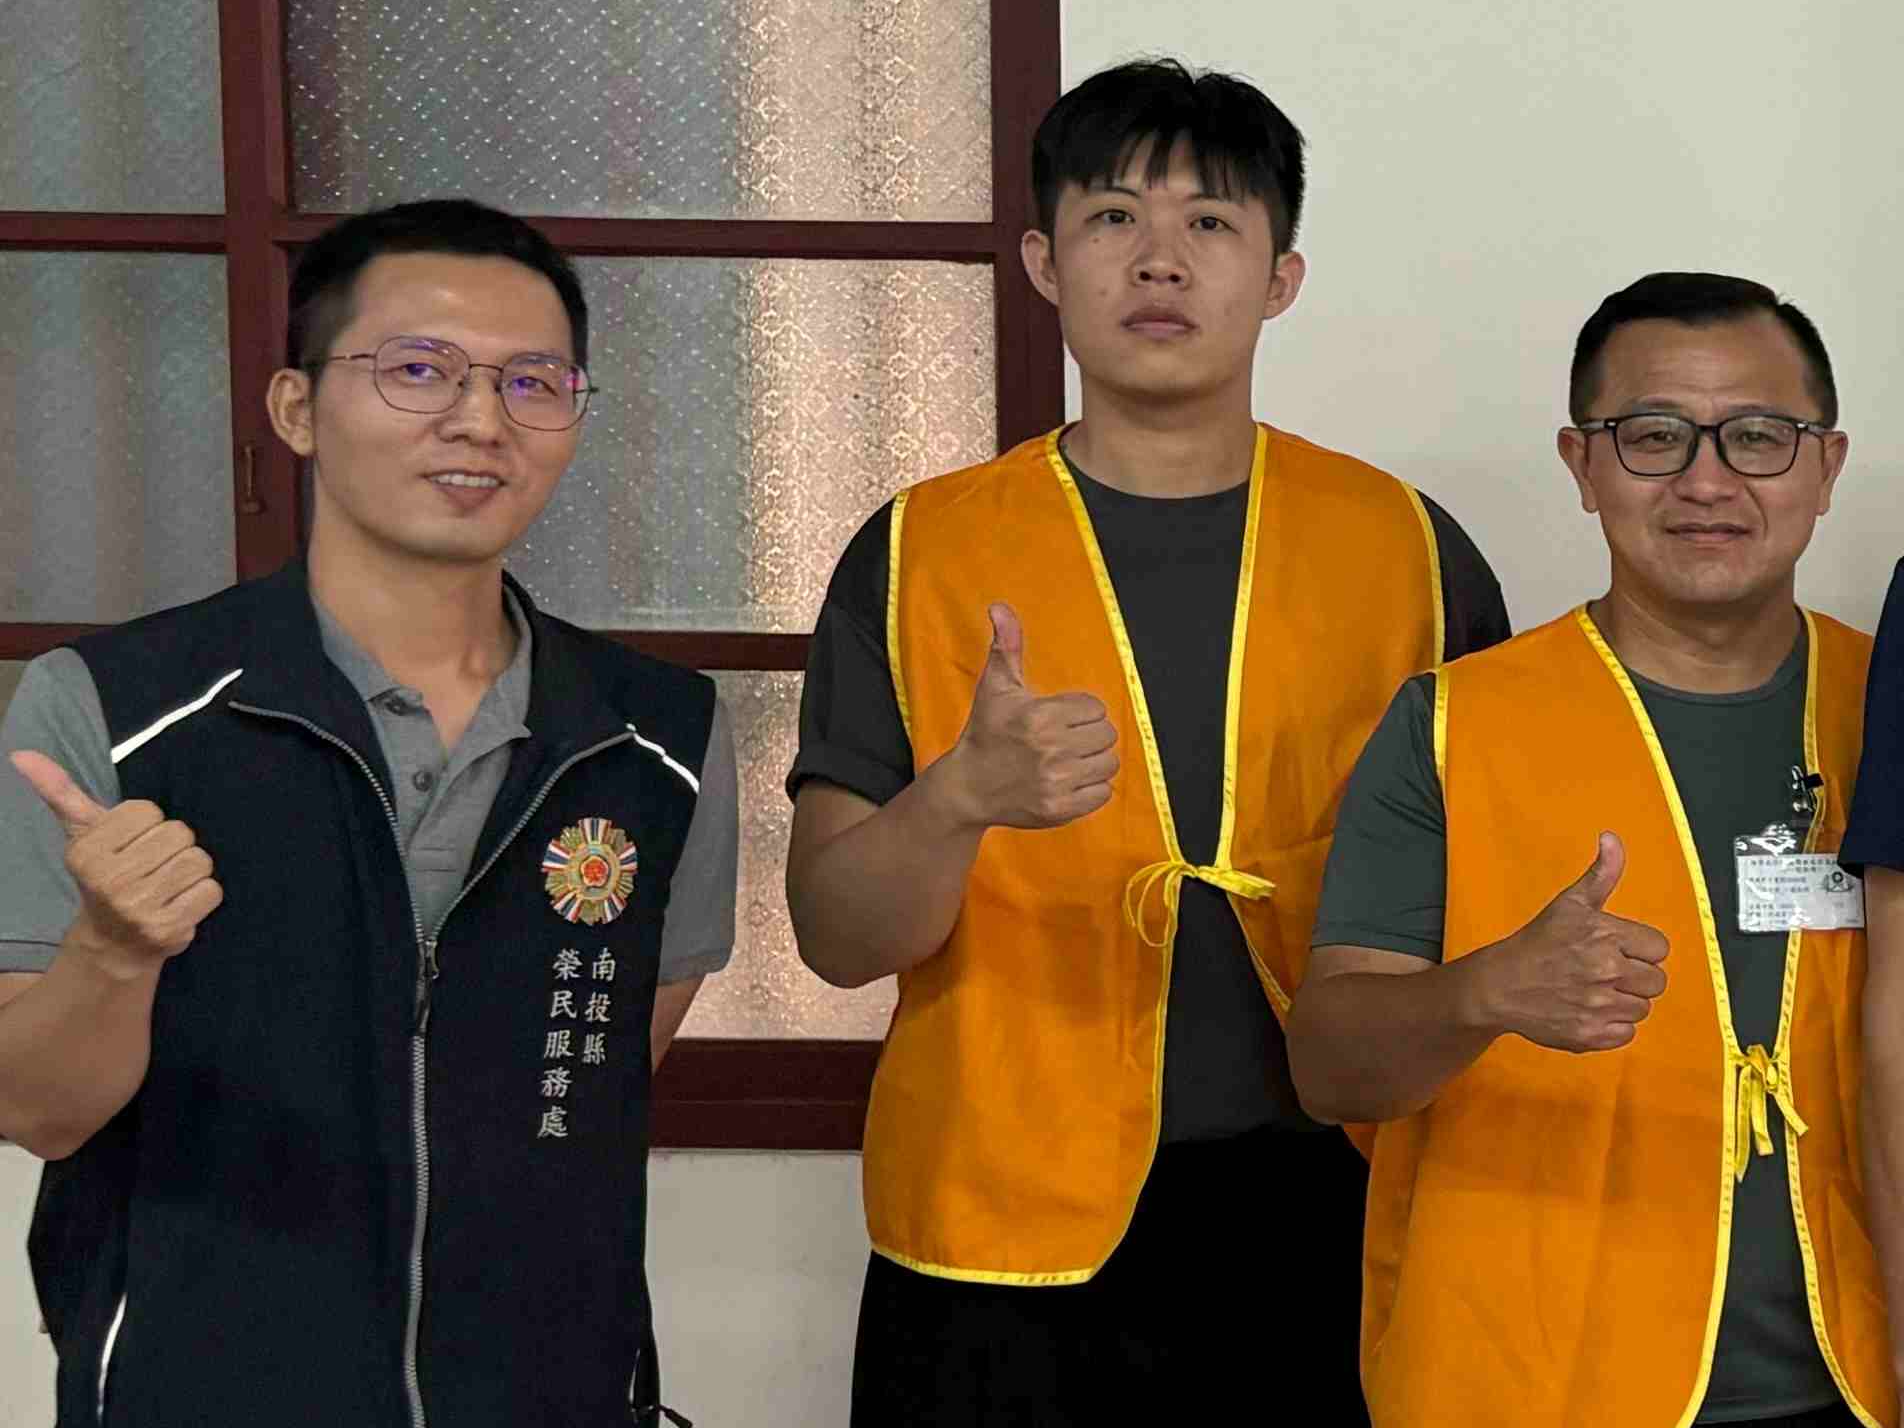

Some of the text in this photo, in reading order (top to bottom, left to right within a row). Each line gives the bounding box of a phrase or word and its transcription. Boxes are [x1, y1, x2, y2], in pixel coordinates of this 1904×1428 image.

[536, 947, 583, 1140] 榮民服務處
[581, 947, 617, 1066] 南投縣
